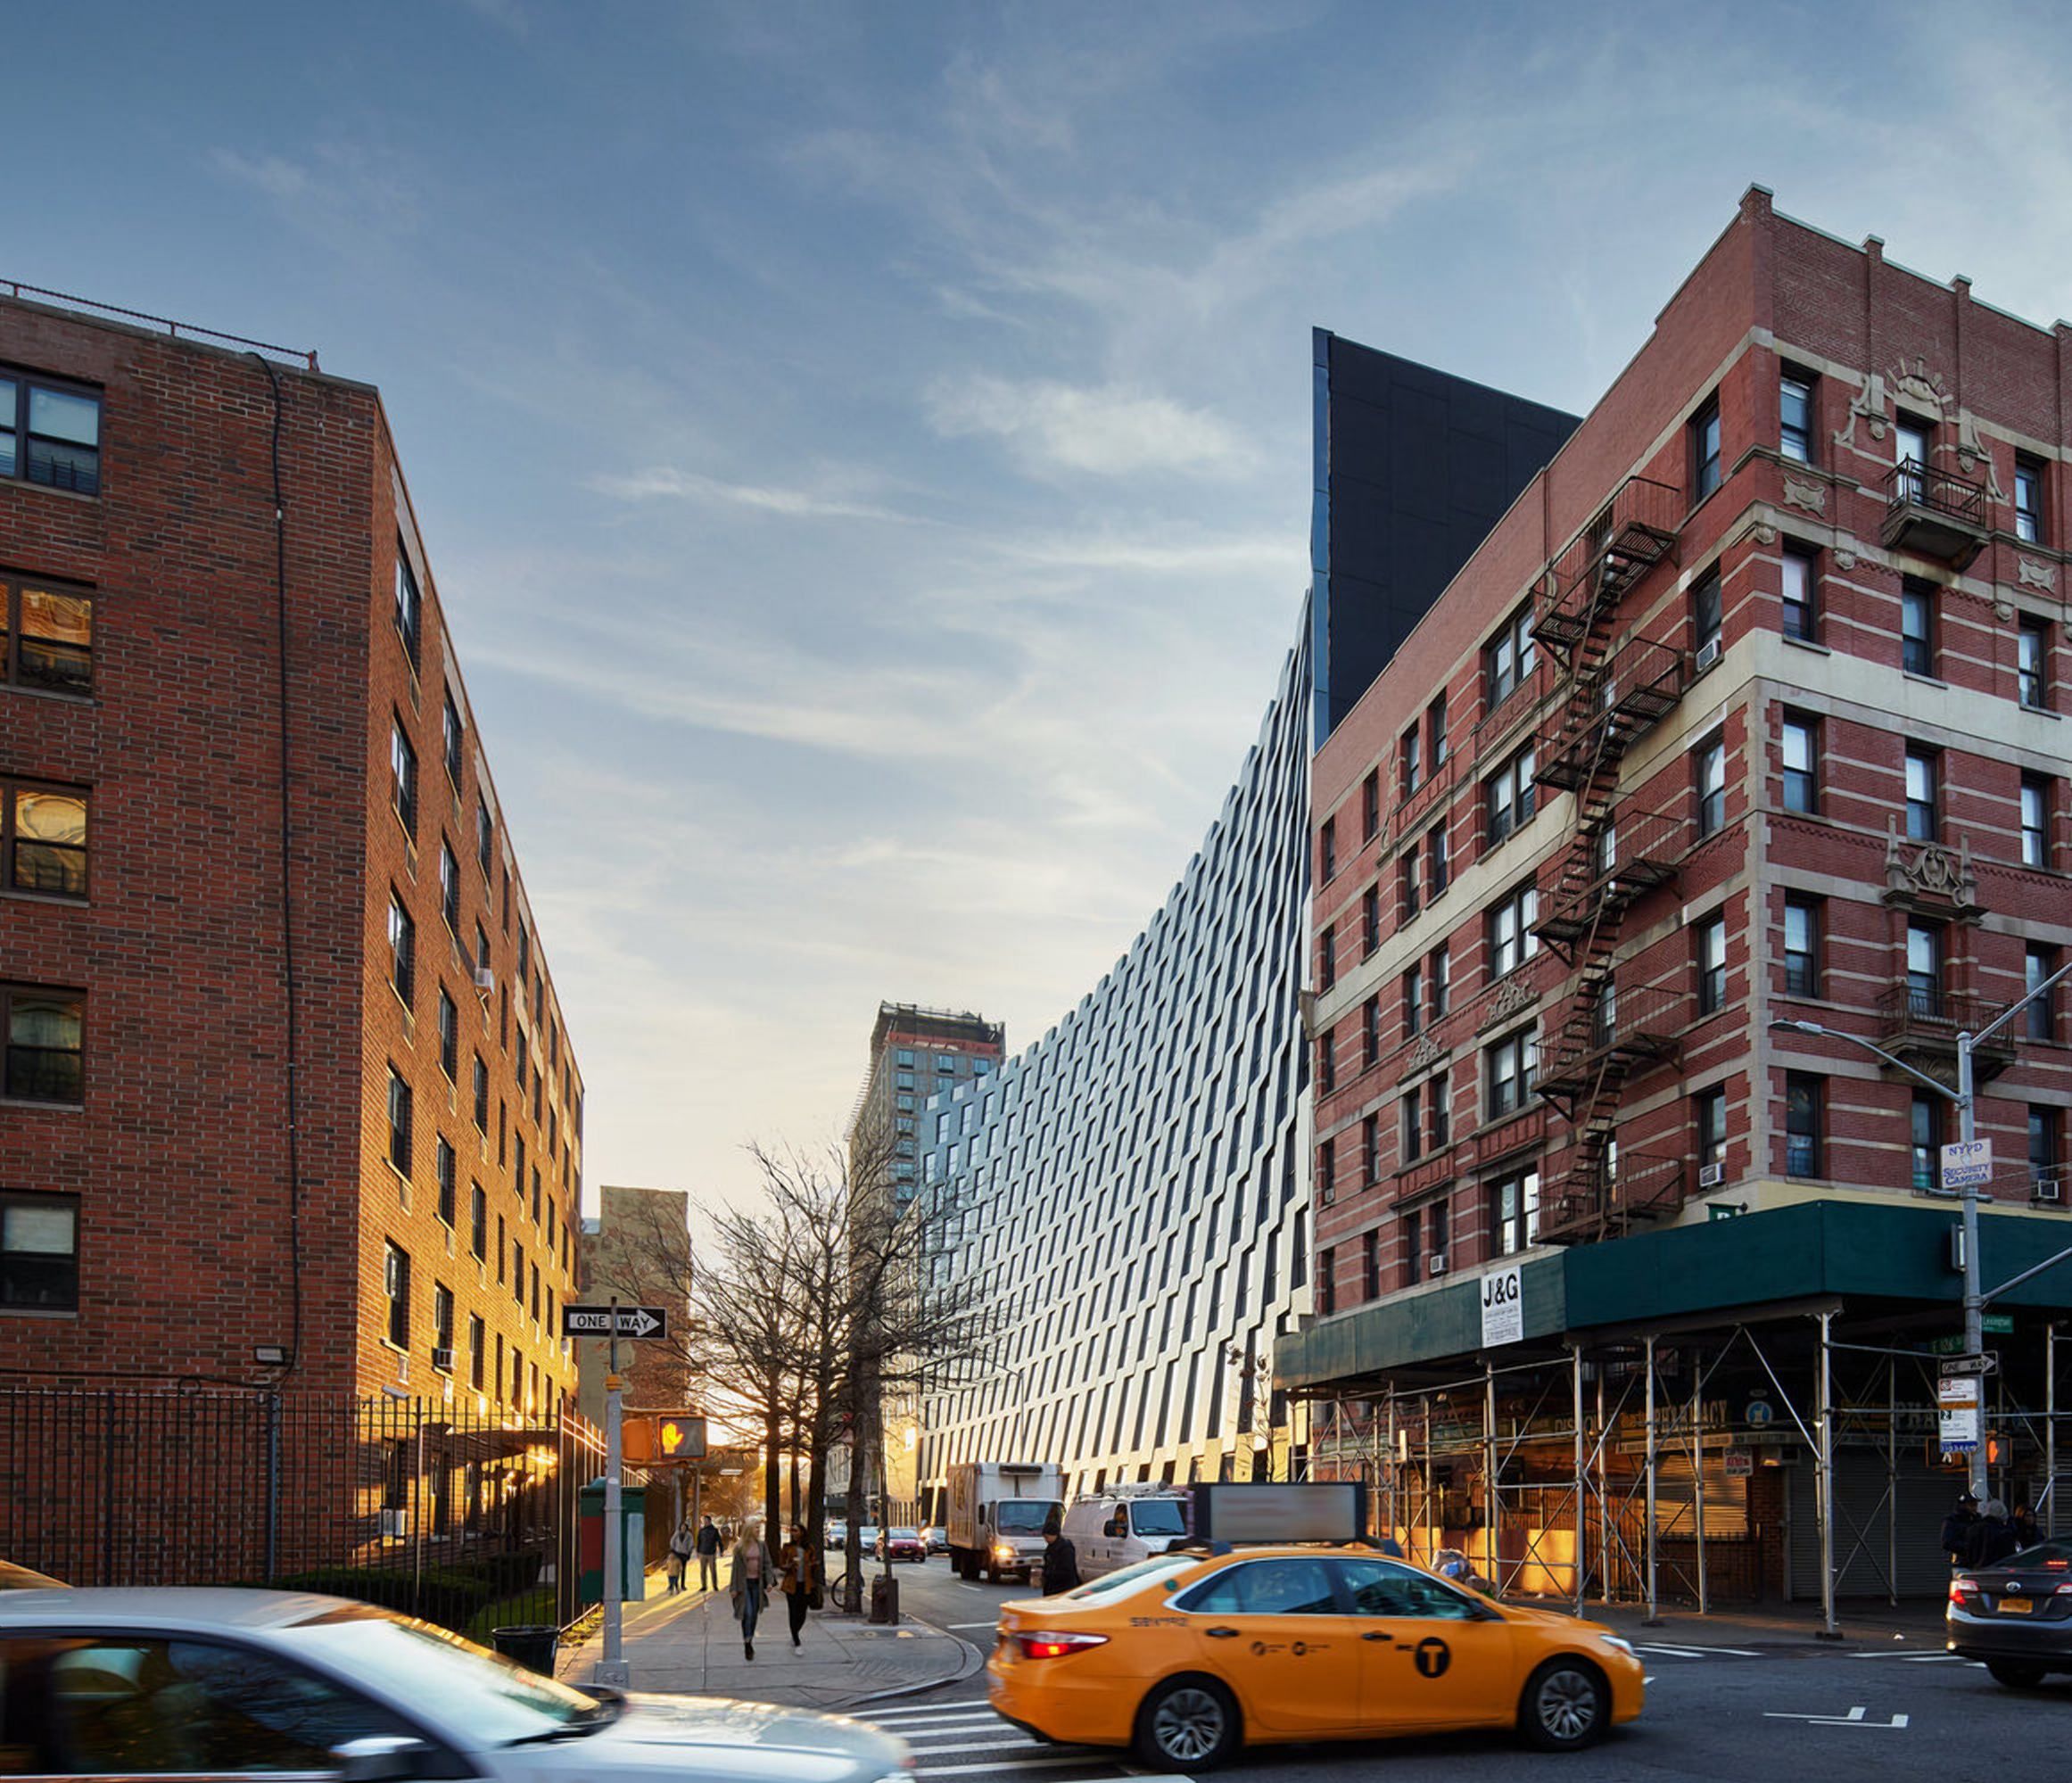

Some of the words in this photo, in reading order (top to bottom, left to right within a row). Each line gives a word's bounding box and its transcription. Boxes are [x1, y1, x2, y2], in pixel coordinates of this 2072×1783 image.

[1949, 1143, 1983, 1156] NYPD
[1483, 1273, 1518, 1308] J&G
[577, 1316, 607, 1327] ONE
[620, 1317, 649, 1329] WAY
[1422, 1646, 1444, 1673] T
